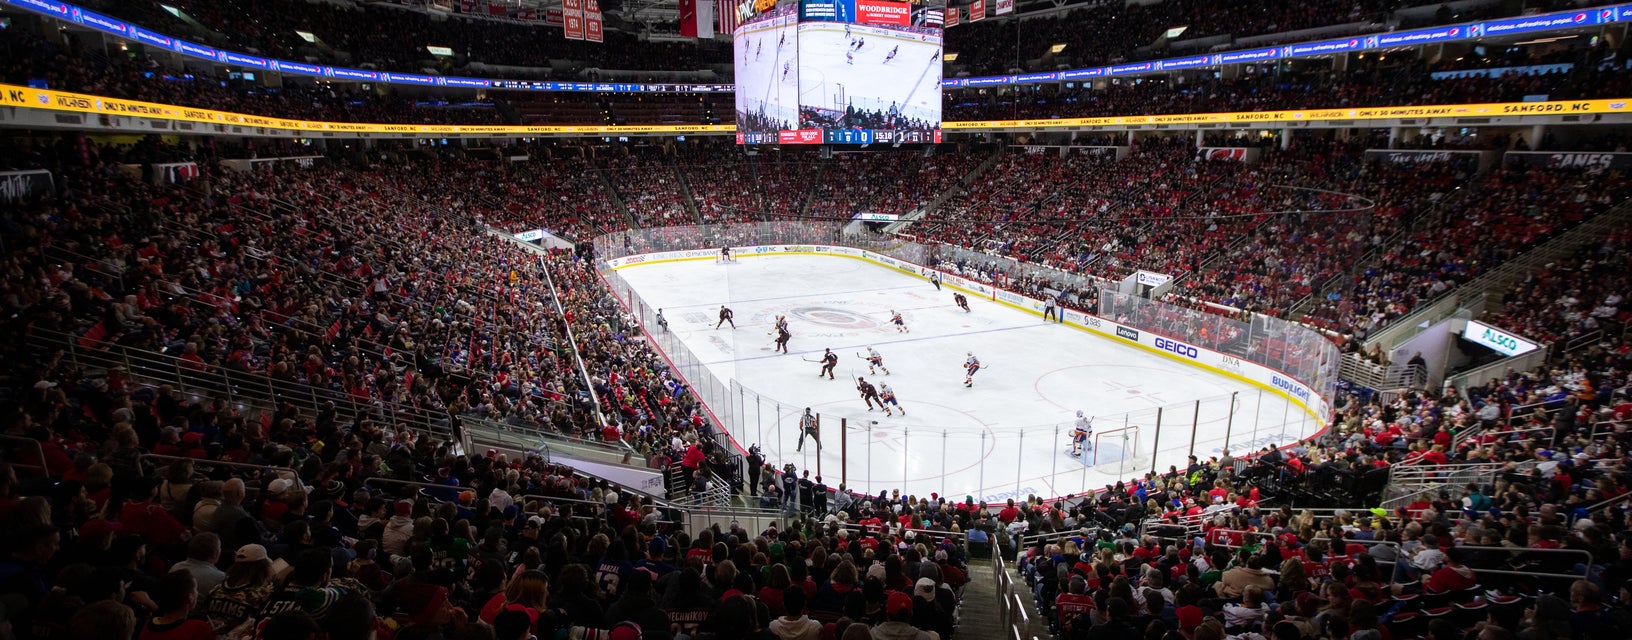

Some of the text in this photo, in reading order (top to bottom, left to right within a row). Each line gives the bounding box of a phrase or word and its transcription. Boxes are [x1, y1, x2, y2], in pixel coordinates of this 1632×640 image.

[859, 4, 908, 14] WOODBRIDGE
[10, 90, 25, 103] NC
[1390, 108, 1424, 116] MINUTES
[1426, 107, 1452, 115] AWAY
[1571, 102, 1590, 111] NC
[861, 131, 868, 141] 0
[875, 132, 893, 140] 15:18
[899, 131, 905, 141] 1
[1117, 328, 1137, 341] Lenovo
[1482, 328, 1517, 351] ALSCO
[1155, 337, 1198, 359] GEICO
[1272, 375, 1289, 392] BUD
